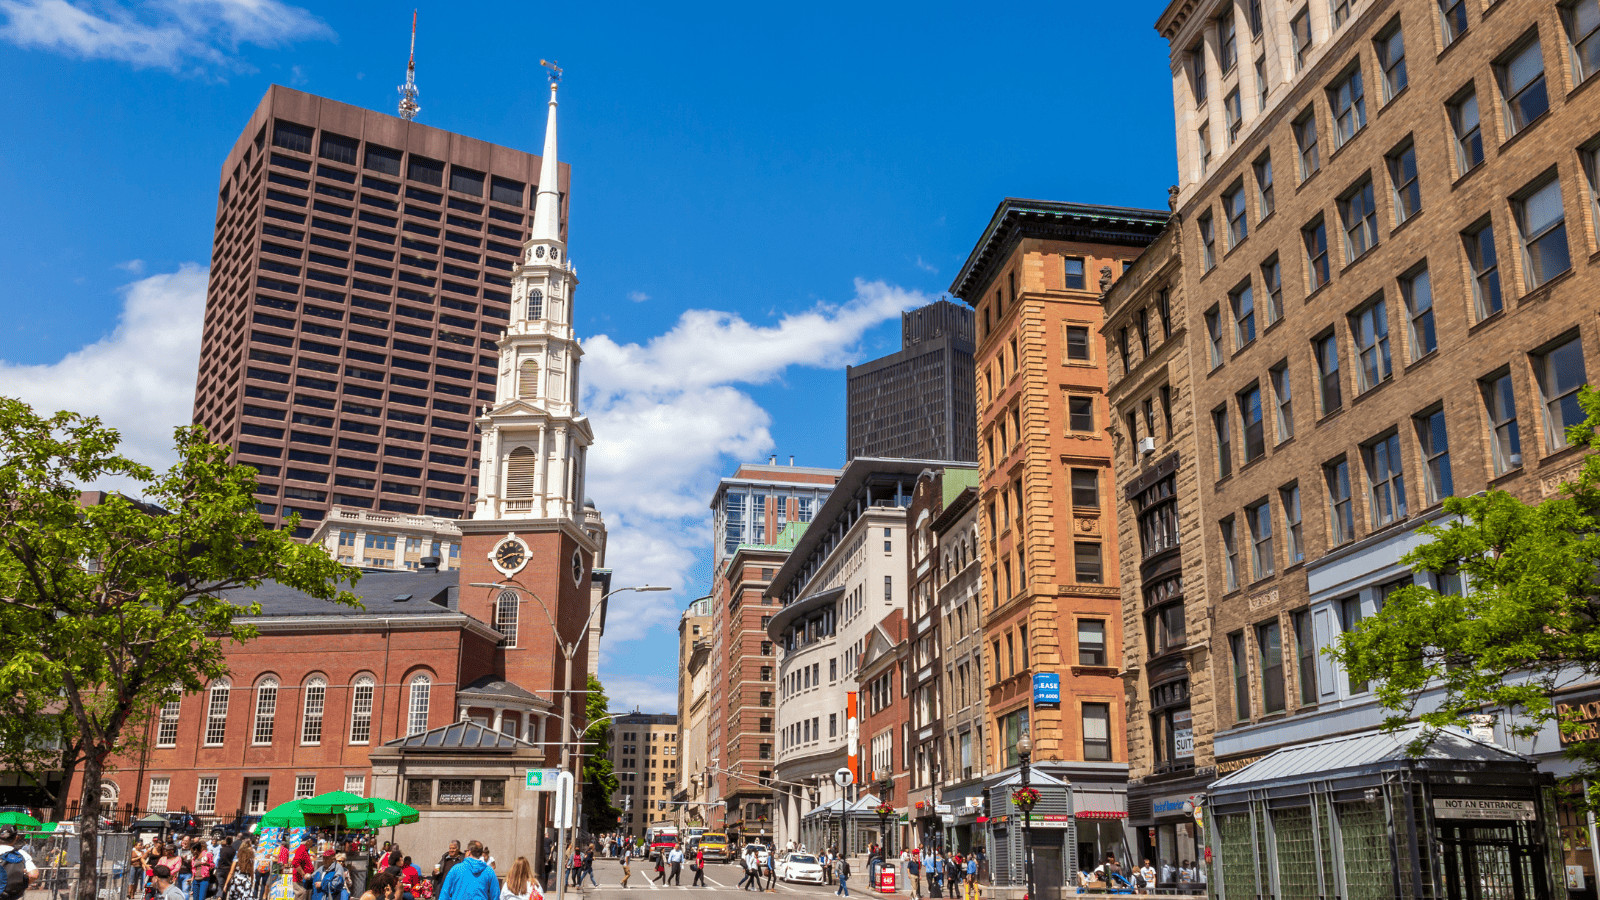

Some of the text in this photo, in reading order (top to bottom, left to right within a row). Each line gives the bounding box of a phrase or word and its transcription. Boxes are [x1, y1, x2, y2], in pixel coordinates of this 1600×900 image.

[1177, 738, 1194, 750] SUIT
[838, 772, 850, 782] T
[1445, 800, 1462, 808] NOT
[1479, 801, 1523, 809] ENTRANCE
